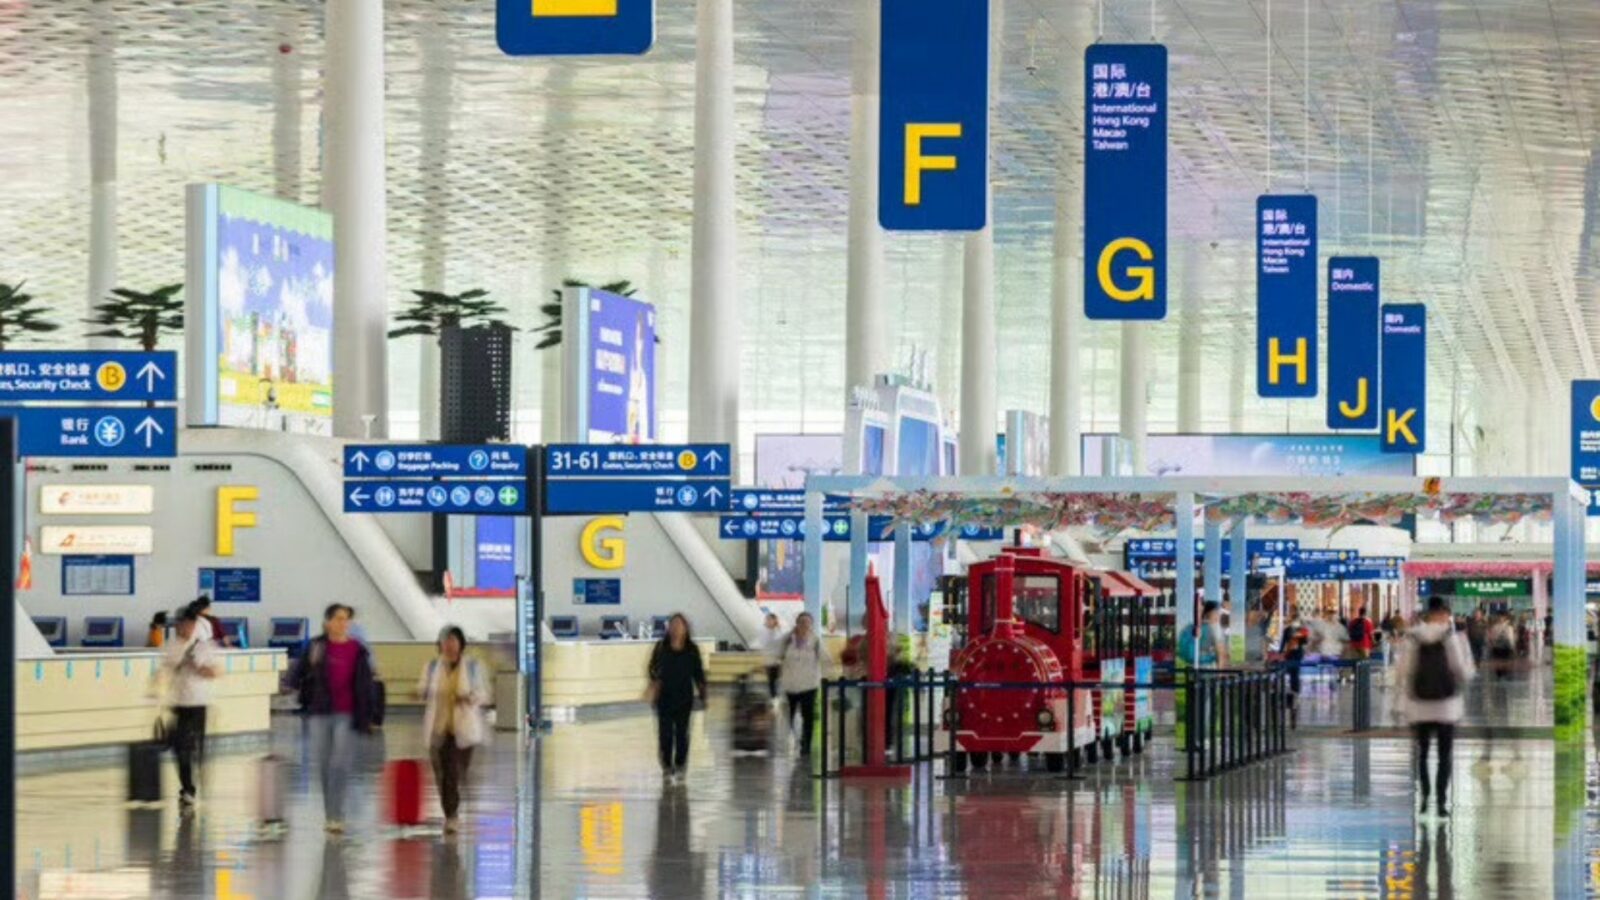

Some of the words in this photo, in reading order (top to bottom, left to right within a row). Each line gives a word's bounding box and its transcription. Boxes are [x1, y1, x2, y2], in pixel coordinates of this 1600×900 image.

[1093, 63, 1126, 79] 国际
[1093, 103, 1157, 113] International
[1093, 115, 1121, 127] Hong
[1122, 115, 1150, 127] Kong
[1093, 128, 1127, 138] Macao
[1093, 140, 1129, 150] Taiwan
[904, 123, 962, 205] F
[1263, 239, 1310, 247] International
[1263, 248, 1284, 256] Hong
[1284, 248, 1305, 257] Kong
[1097, 237, 1155, 302] G
[1263, 266, 1290, 274] Taiwan
[1332, 282, 1374, 292] Domestic
[1384, 325, 1421, 334] Domestic
[1268, 337, 1307, 385] H
[59, 378, 92, 391] Check
[1338, 377, 1368, 418] J
[61, 418, 90, 431] 银行
[1387, 408, 1418, 444] K
[60, 434, 89, 445] Bank
[551, 450, 599, 470] 31-61
[653, 461, 674, 469] Check
[655, 498, 674, 506] Bank
[216, 486, 260, 557] F
[580, 516, 629, 571] G
